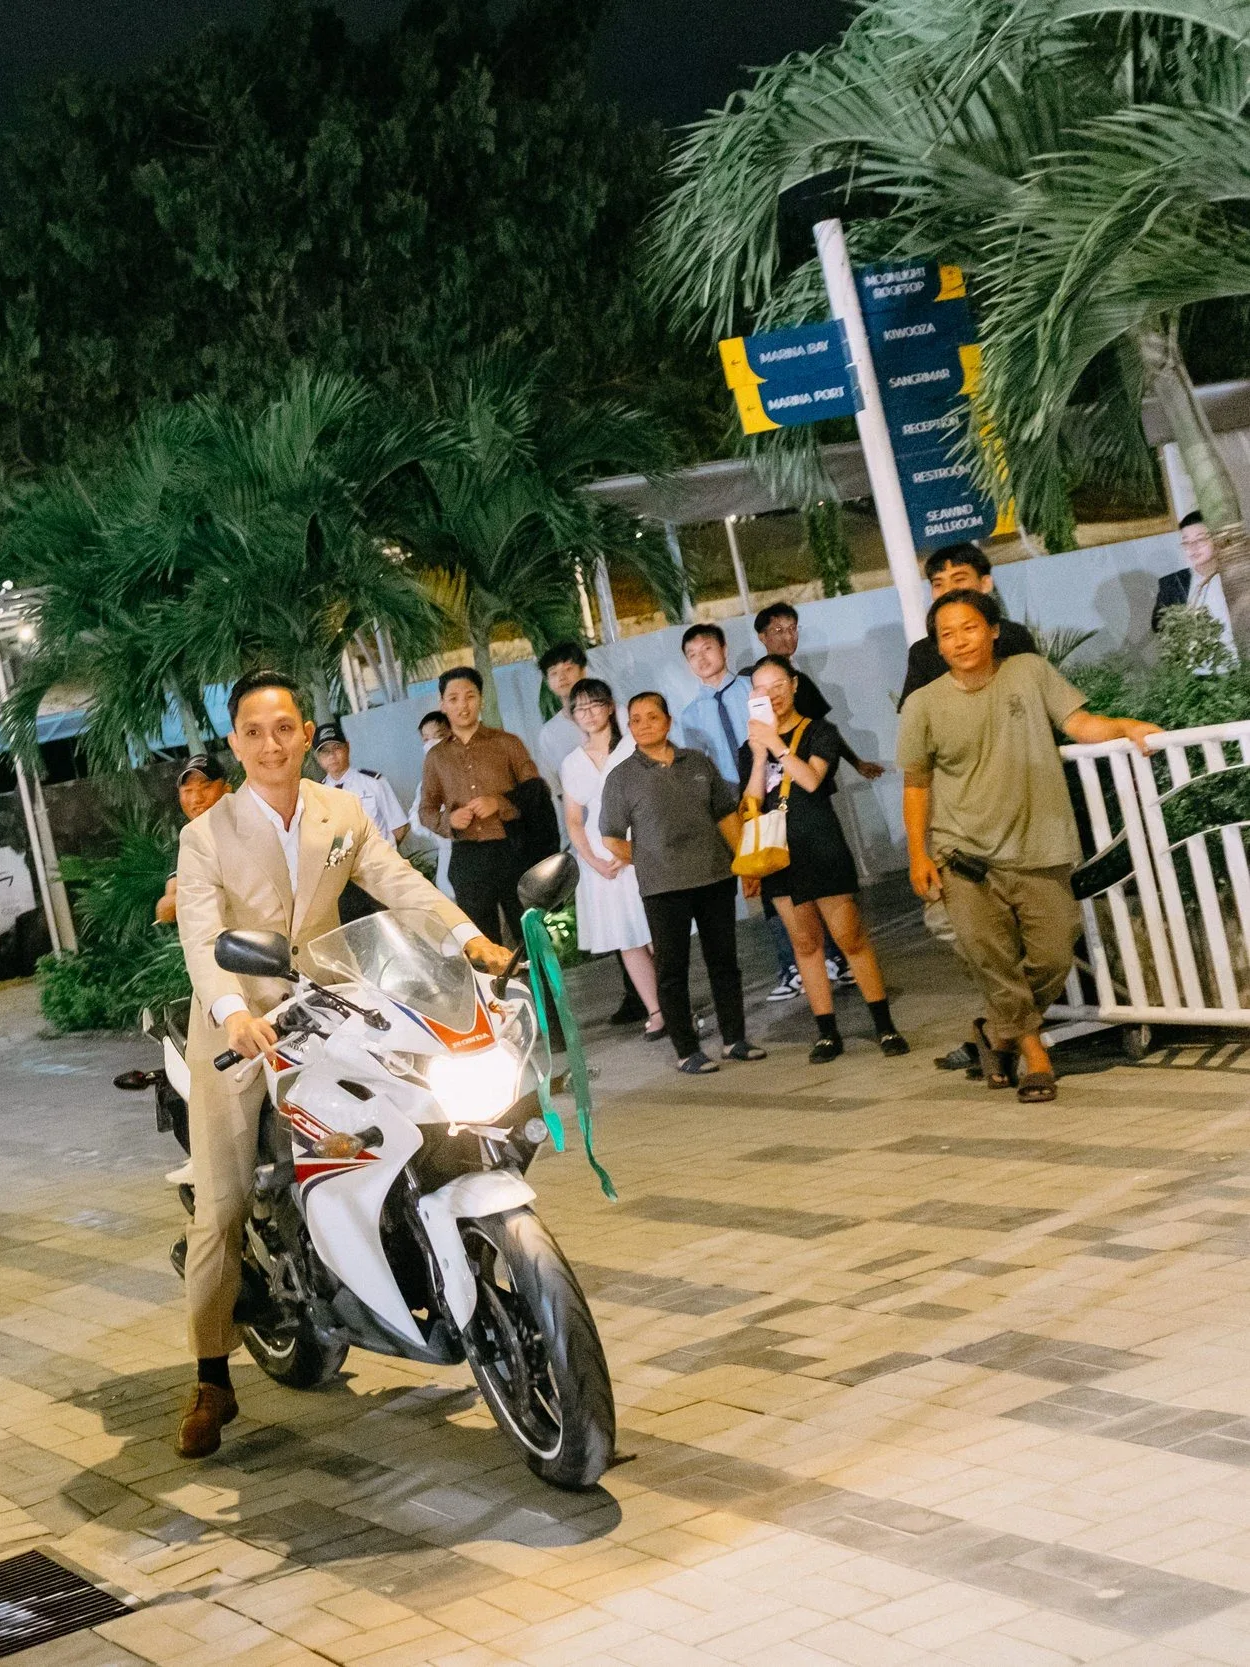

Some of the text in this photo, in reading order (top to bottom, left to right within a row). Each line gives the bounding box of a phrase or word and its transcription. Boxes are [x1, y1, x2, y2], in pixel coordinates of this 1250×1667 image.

[872, 281, 925, 299] ROOFTOP
[759, 340, 829, 364] MARINA BAY
[767, 386, 845, 411] MARINA PORT
[902, 415, 960, 435] RECEPTION
[926, 504, 973, 521] SEAWIND
[924, 515, 983, 537] BALLROOM
[452, 1032, 491, 1049] HONDA
